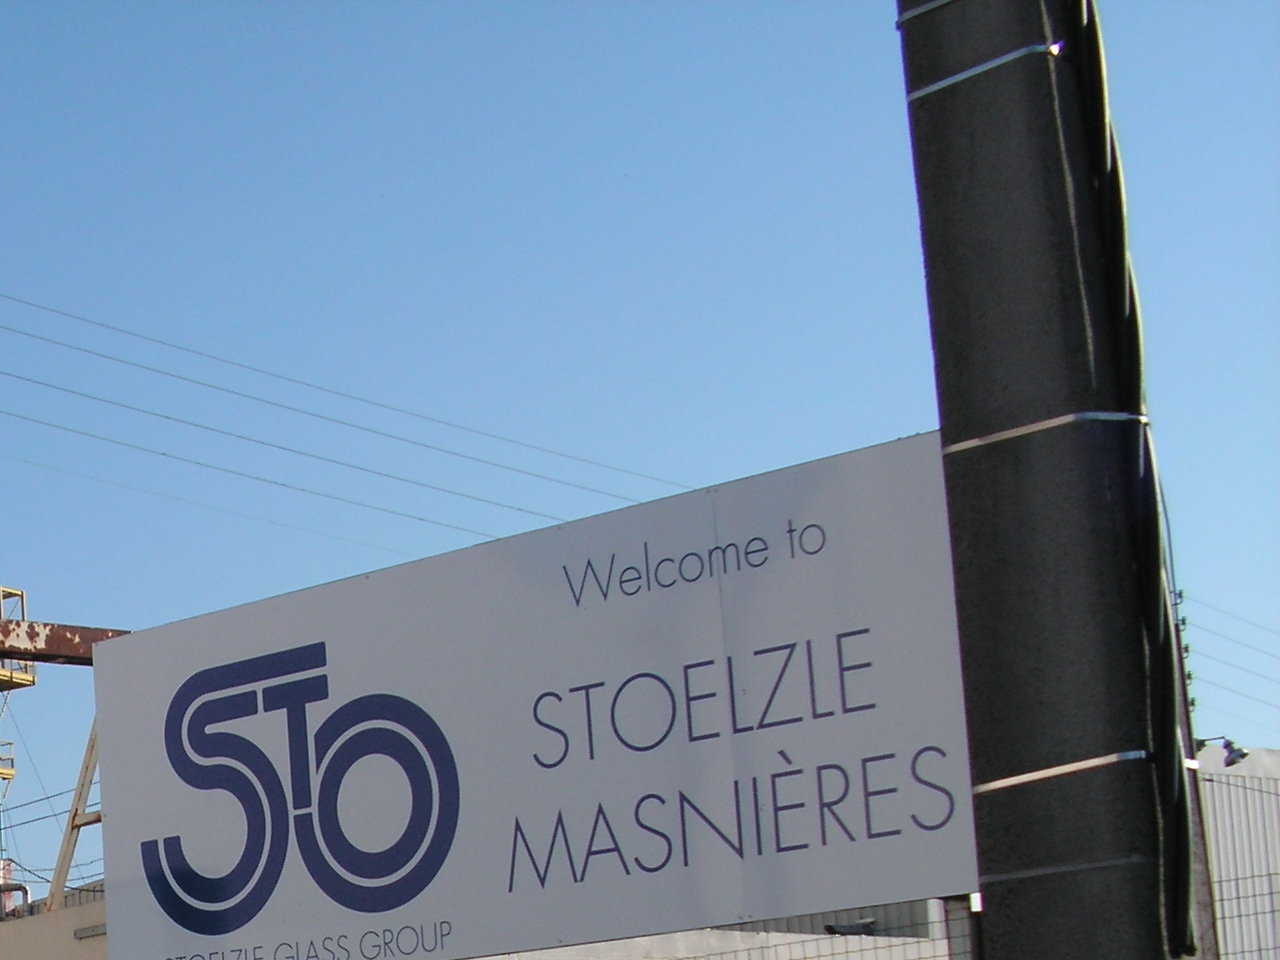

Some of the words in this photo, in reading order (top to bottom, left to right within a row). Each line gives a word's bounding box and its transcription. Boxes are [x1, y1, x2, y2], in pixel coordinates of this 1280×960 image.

[562, 541, 769, 607] Welcome
[786, 518, 827, 559] to
[532, 628, 876, 769] STOELZLE
[508, 745, 955, 893] MASNIÈRES
[358, 920, 453, 960] GROUP
